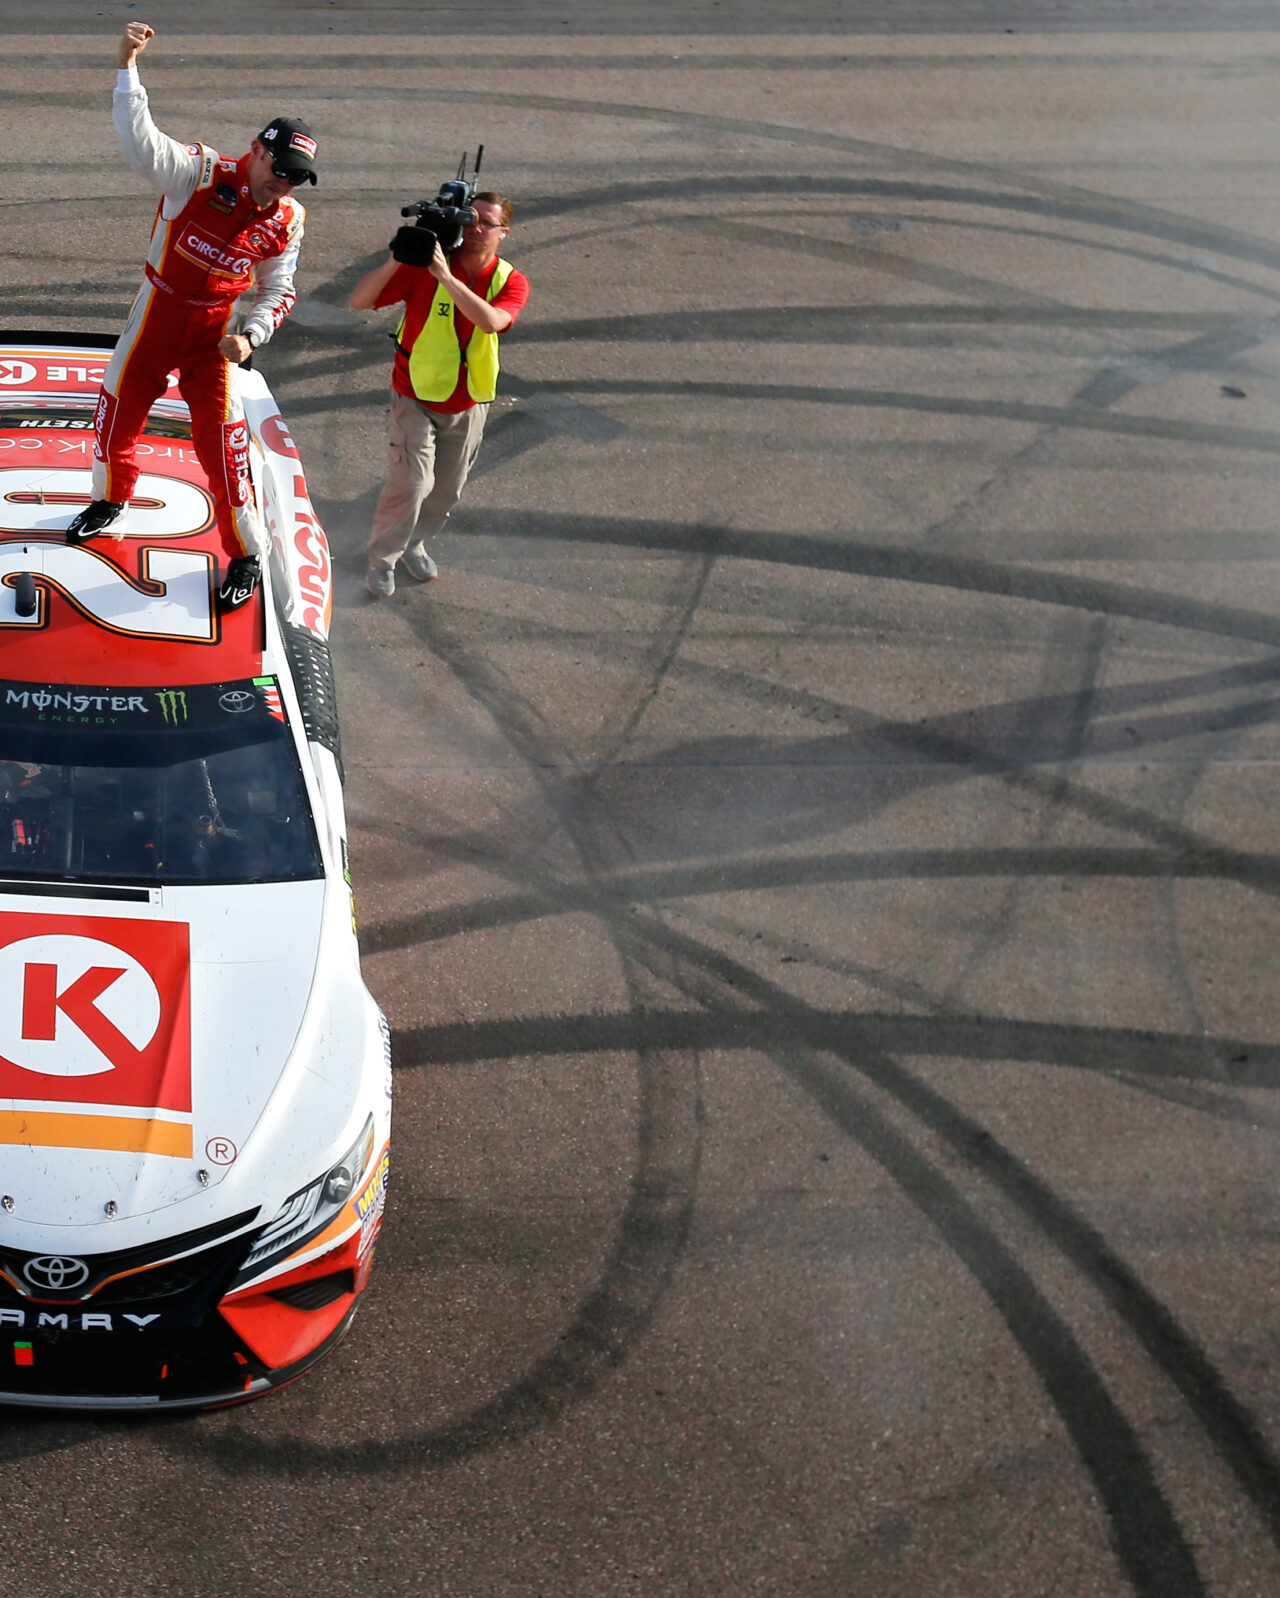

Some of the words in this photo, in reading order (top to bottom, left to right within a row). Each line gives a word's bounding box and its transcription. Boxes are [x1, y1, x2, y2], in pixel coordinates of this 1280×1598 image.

[187, 235, 234, 266] CIRCLE
[437, 302, 450, 317] 32
[38, 714, 118, 725] ENERGY
